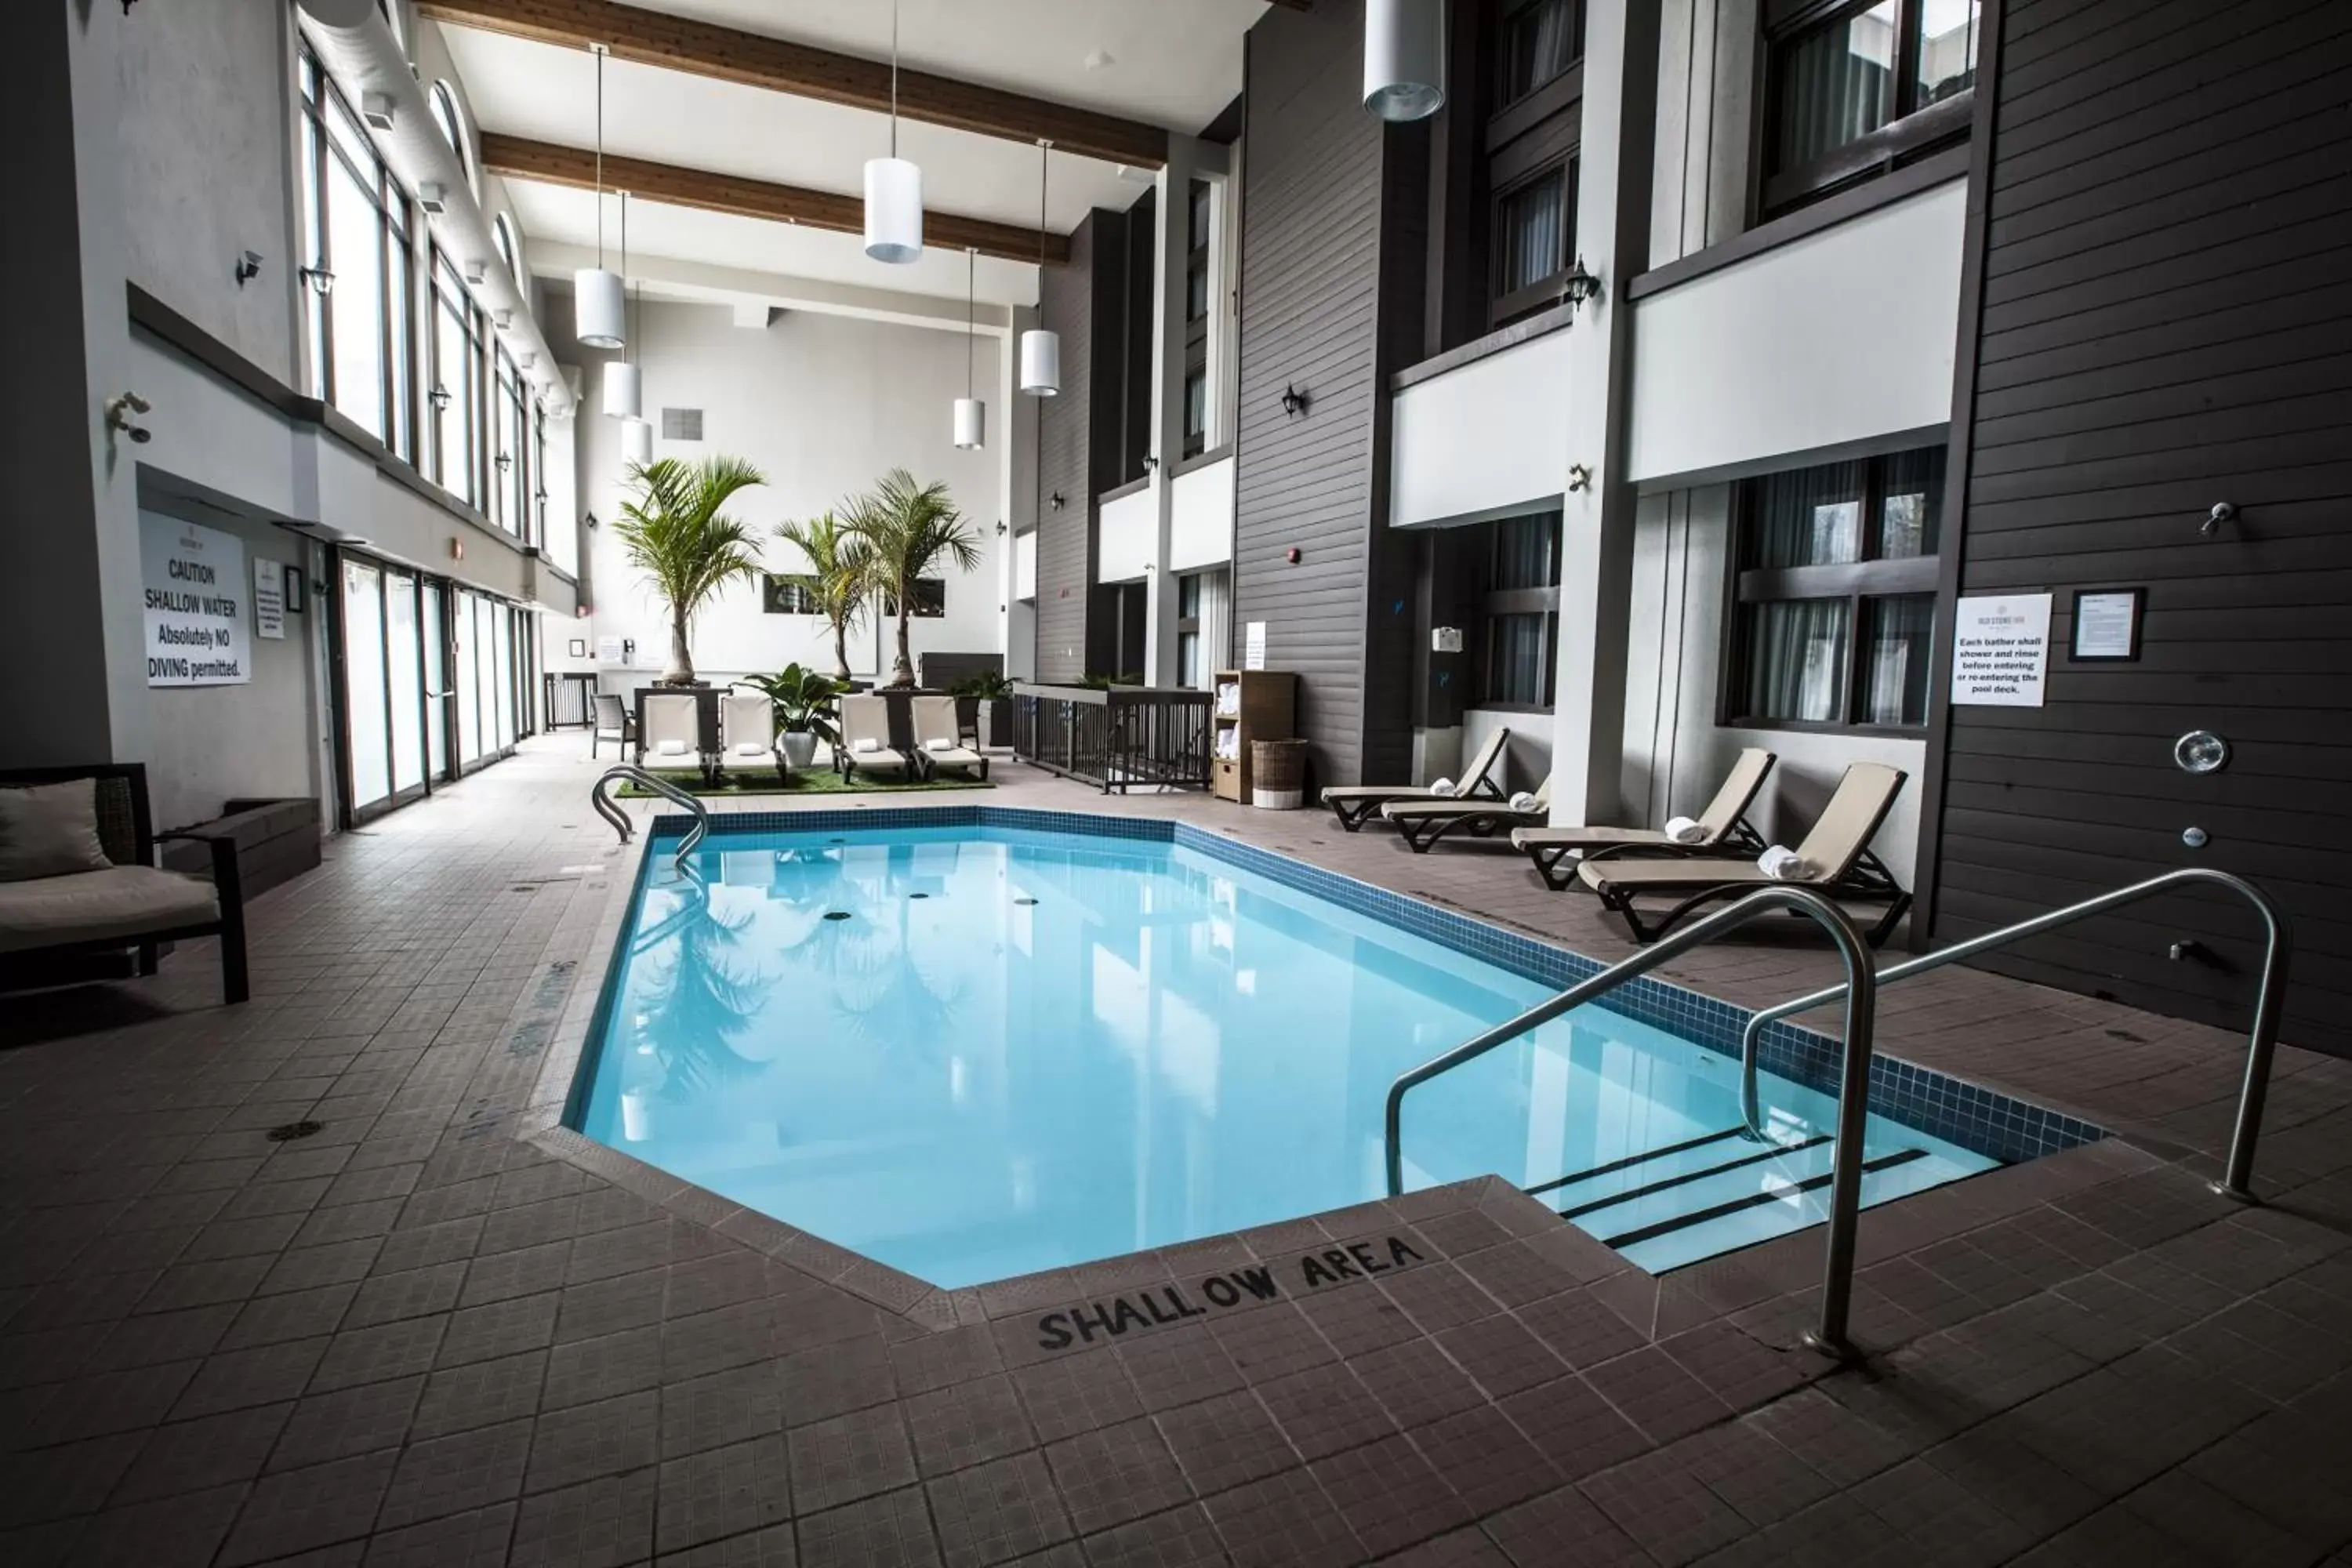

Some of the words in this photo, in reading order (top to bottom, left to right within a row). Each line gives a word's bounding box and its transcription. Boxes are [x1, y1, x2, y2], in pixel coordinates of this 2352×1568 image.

[169, 558, 215, 584] CAUTION
[145, 589, 200, 615] SHALLOW
[203, 596, 236, 617] WATER
[158, 623, 213, 650] Absolutely
[216, 629, 230, 647] NO
[1959, 637, 1983, 647] Each
[1984, 637, 2016, 646] bather
[2018, 637, 2042, 645] shall
[1994, 649, 2013, 658] and
[148, 658, 189, 678] DIVING
[191, 659, 241, 681] permitted.
[1962, 661, 1991, 670] before
[1994, 662, 2034, 672] entering
[1969, 673, 2020, 683] re-entering
[1972, 684, 1992, 694] pool
[1994, 684, 2020, 694] deck.
[1039, 1265, 1277, 1350] SHALLOW
[1303, 1236, 1424, 1287] AREA
